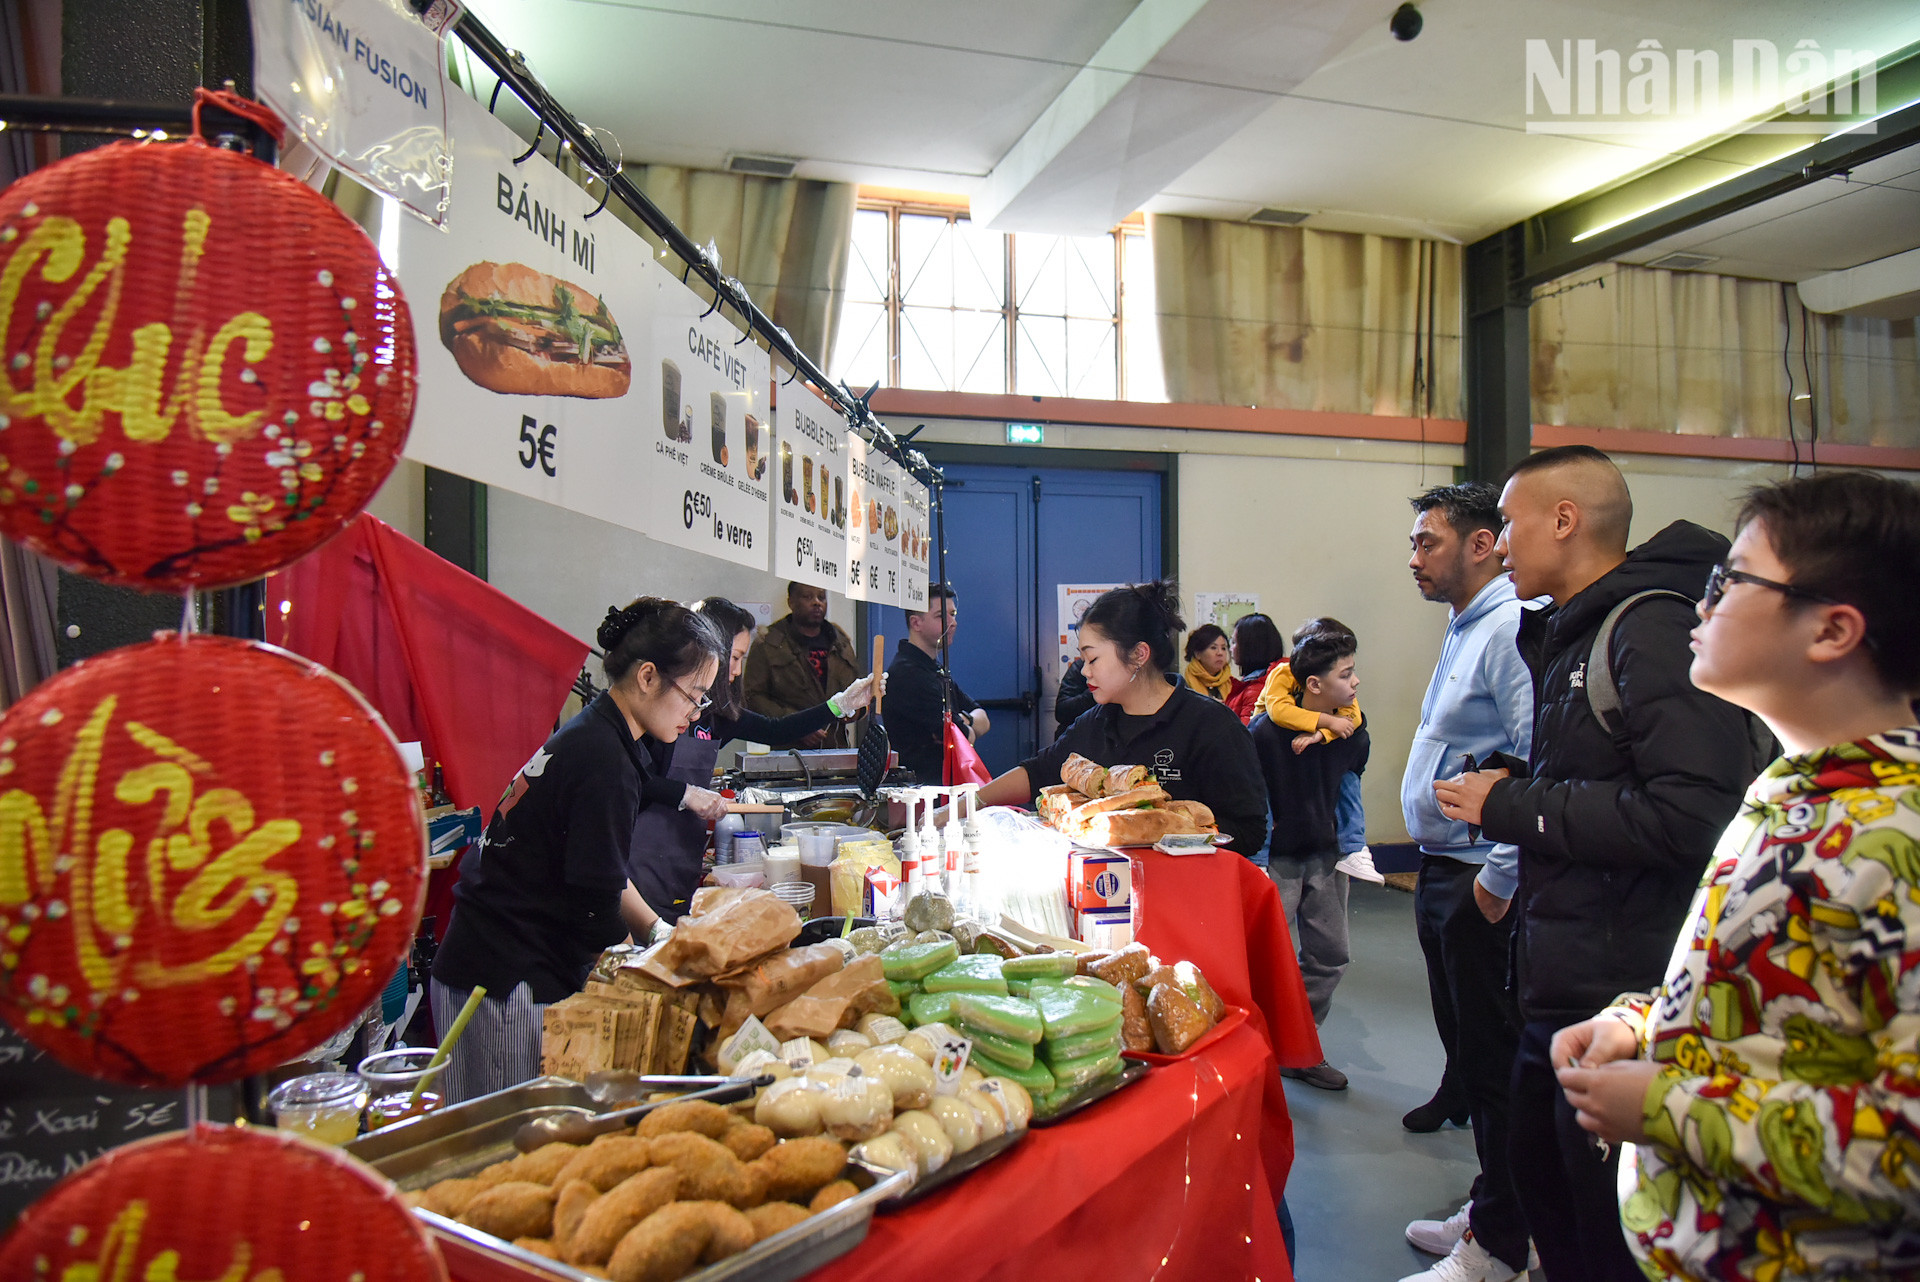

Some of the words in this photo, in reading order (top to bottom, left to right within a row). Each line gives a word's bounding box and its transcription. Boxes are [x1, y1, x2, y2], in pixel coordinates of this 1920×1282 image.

[294, 0, 349, 53] SIAN
[355, 37, 428, 109] FUSION
[497, 171, 565, 254] BÁNH
[573, 229, 595, 275] MÌ
[688, 326, 721, 372] CAFÉ
[723, 351, 747, 391] VIỆT
[518, 414, 557, 477] 5€
[795, 408, 824, 447] BUBBLE
[825, 430, 839, 457] TEA
[852, 457, 875, 486] BUBBLE
[876, 471, 895, 497] WAFFLE
[683, 489, 711, 530] 6€50
[713, 512, 723, 540] le
[726, 523, 752, 549] verre
[814, 551, 820, 573] le
[821, 558, 837, 578] verre
[851, 559, 860, 586] 5€
[869, 565, 878, 590] 6€
[887, 569, 896, 594] 7€
